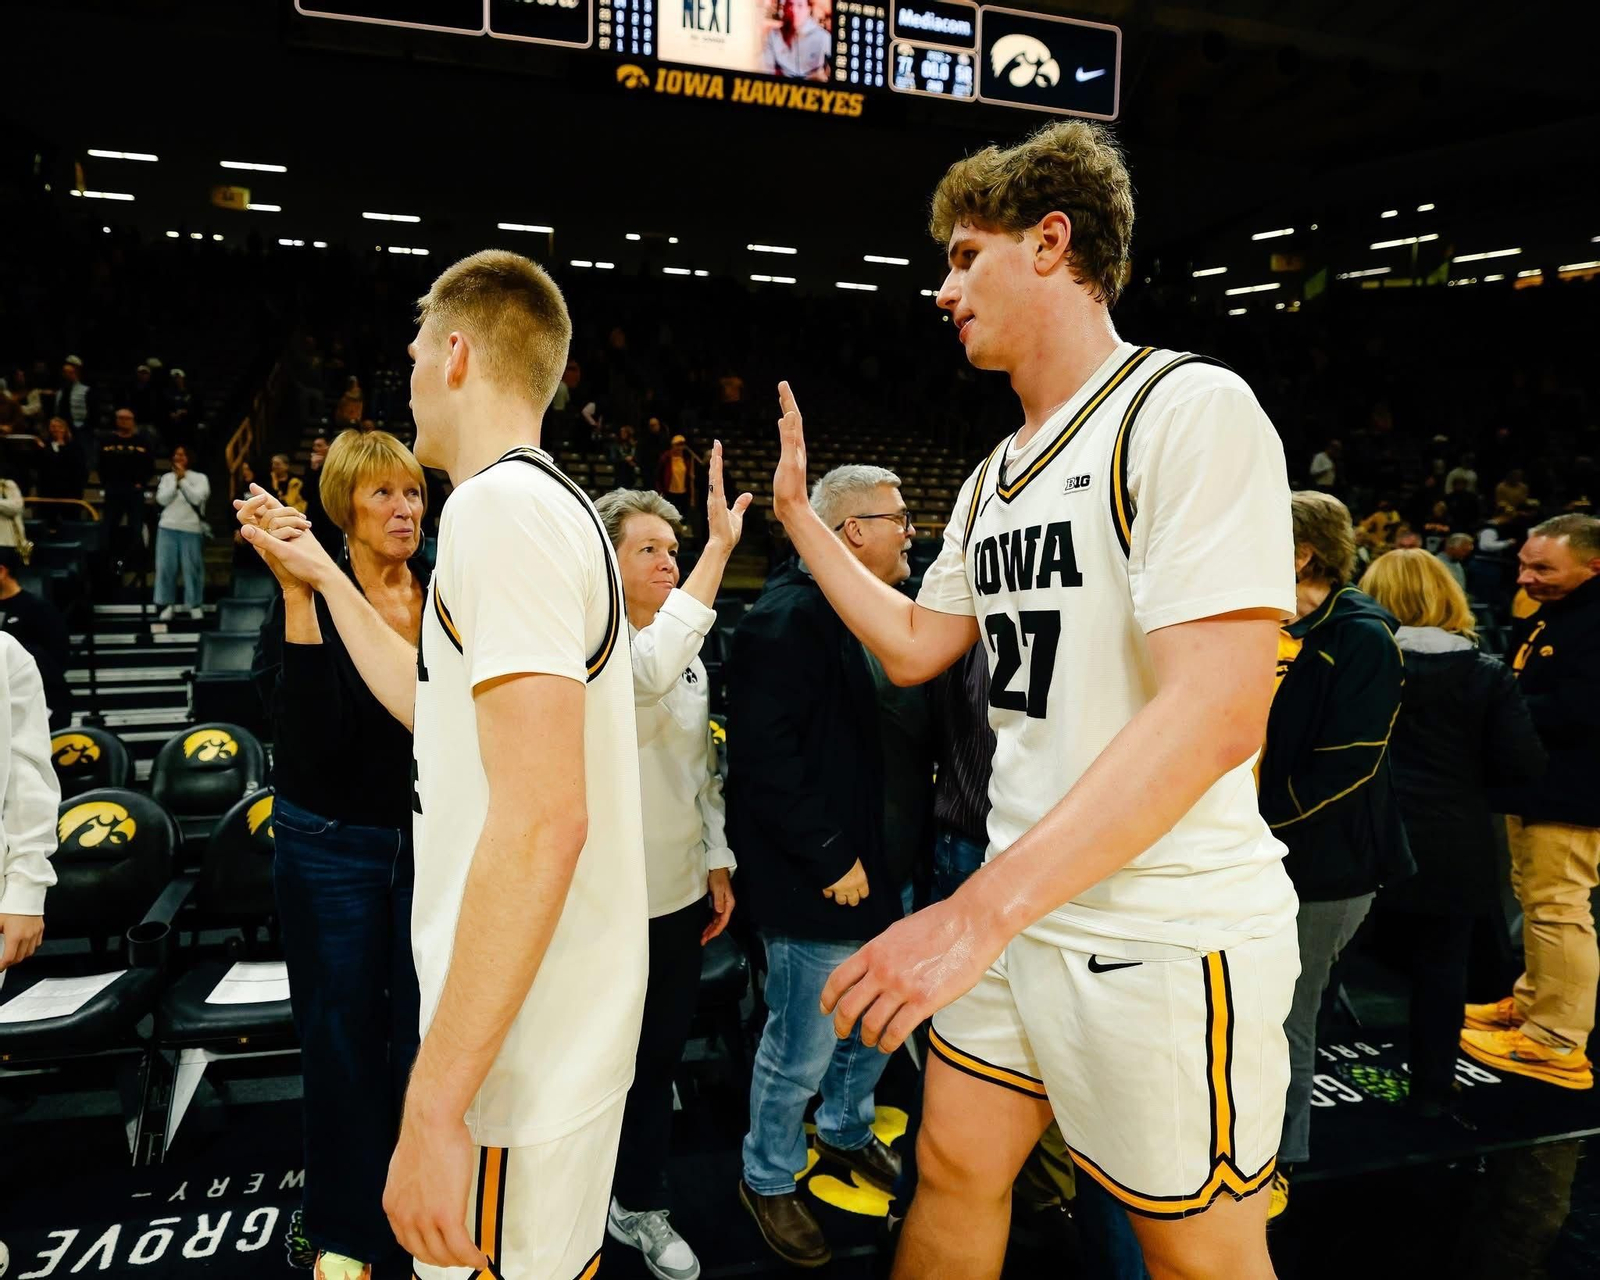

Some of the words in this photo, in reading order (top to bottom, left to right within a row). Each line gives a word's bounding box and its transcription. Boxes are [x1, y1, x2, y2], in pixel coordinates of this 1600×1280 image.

[898, 8, 971, 36] Mediacom
[654, 68, 725, 100] IOWA
[731, 77, 865, 117] HAWKEYES
[974, 520, 1083, 597] IOWA
[985, 610, 1061, 719] 27
[167, 1169, 306, 1202] WERY
[18, 1206, 280, 1280] GROVE
